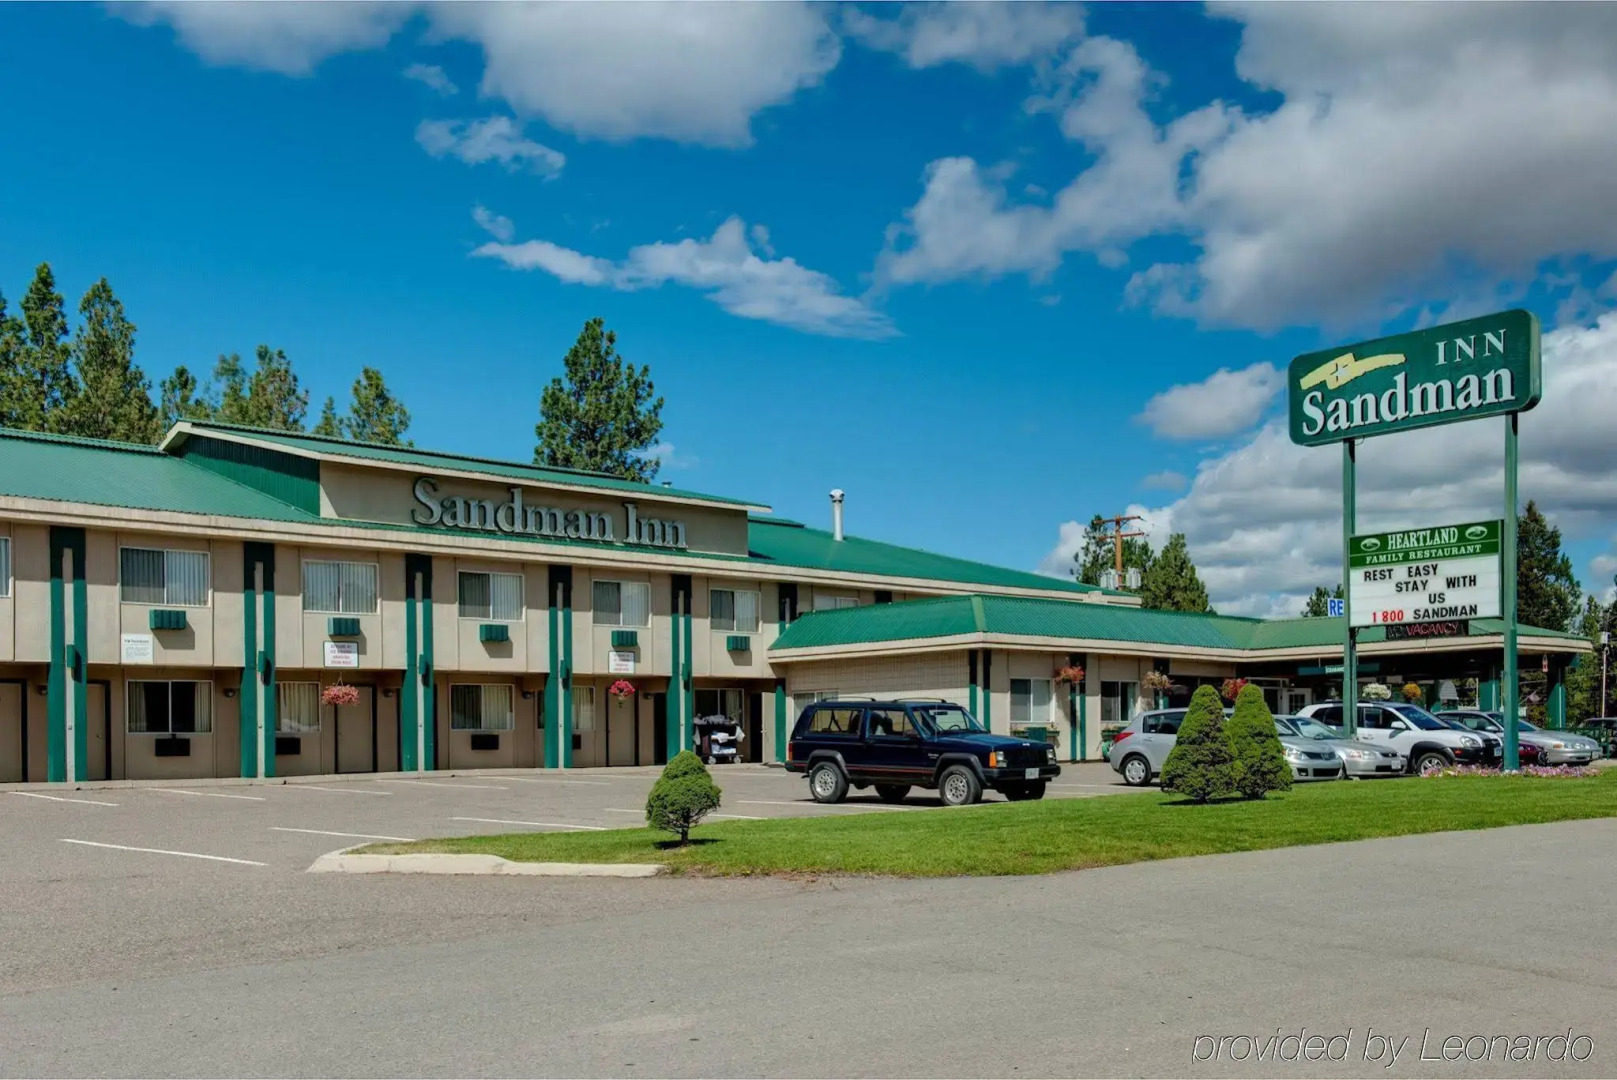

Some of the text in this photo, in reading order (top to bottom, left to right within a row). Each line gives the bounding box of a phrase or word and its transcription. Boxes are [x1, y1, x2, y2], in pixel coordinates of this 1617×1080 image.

[1436, 329, 1506, 366] INN
[1302, 367, 1516, 435] Sandman
[411, 477, 689, 549] Sandman Inn
[1387, 527, 1459, 550] HEARTLAND
[1366, 544, 1482, 565] FAMILY RESTAURANT
[1364, 563, 1438, 582] REST EASY
[1395, 575, 1477, 593] STAY WITH
[1428, 593, 1446, 605] US
[1372, 604, 1478, 623] 1 800 SANDMAN
[1406, 621, 1459, 636] VACANCY
